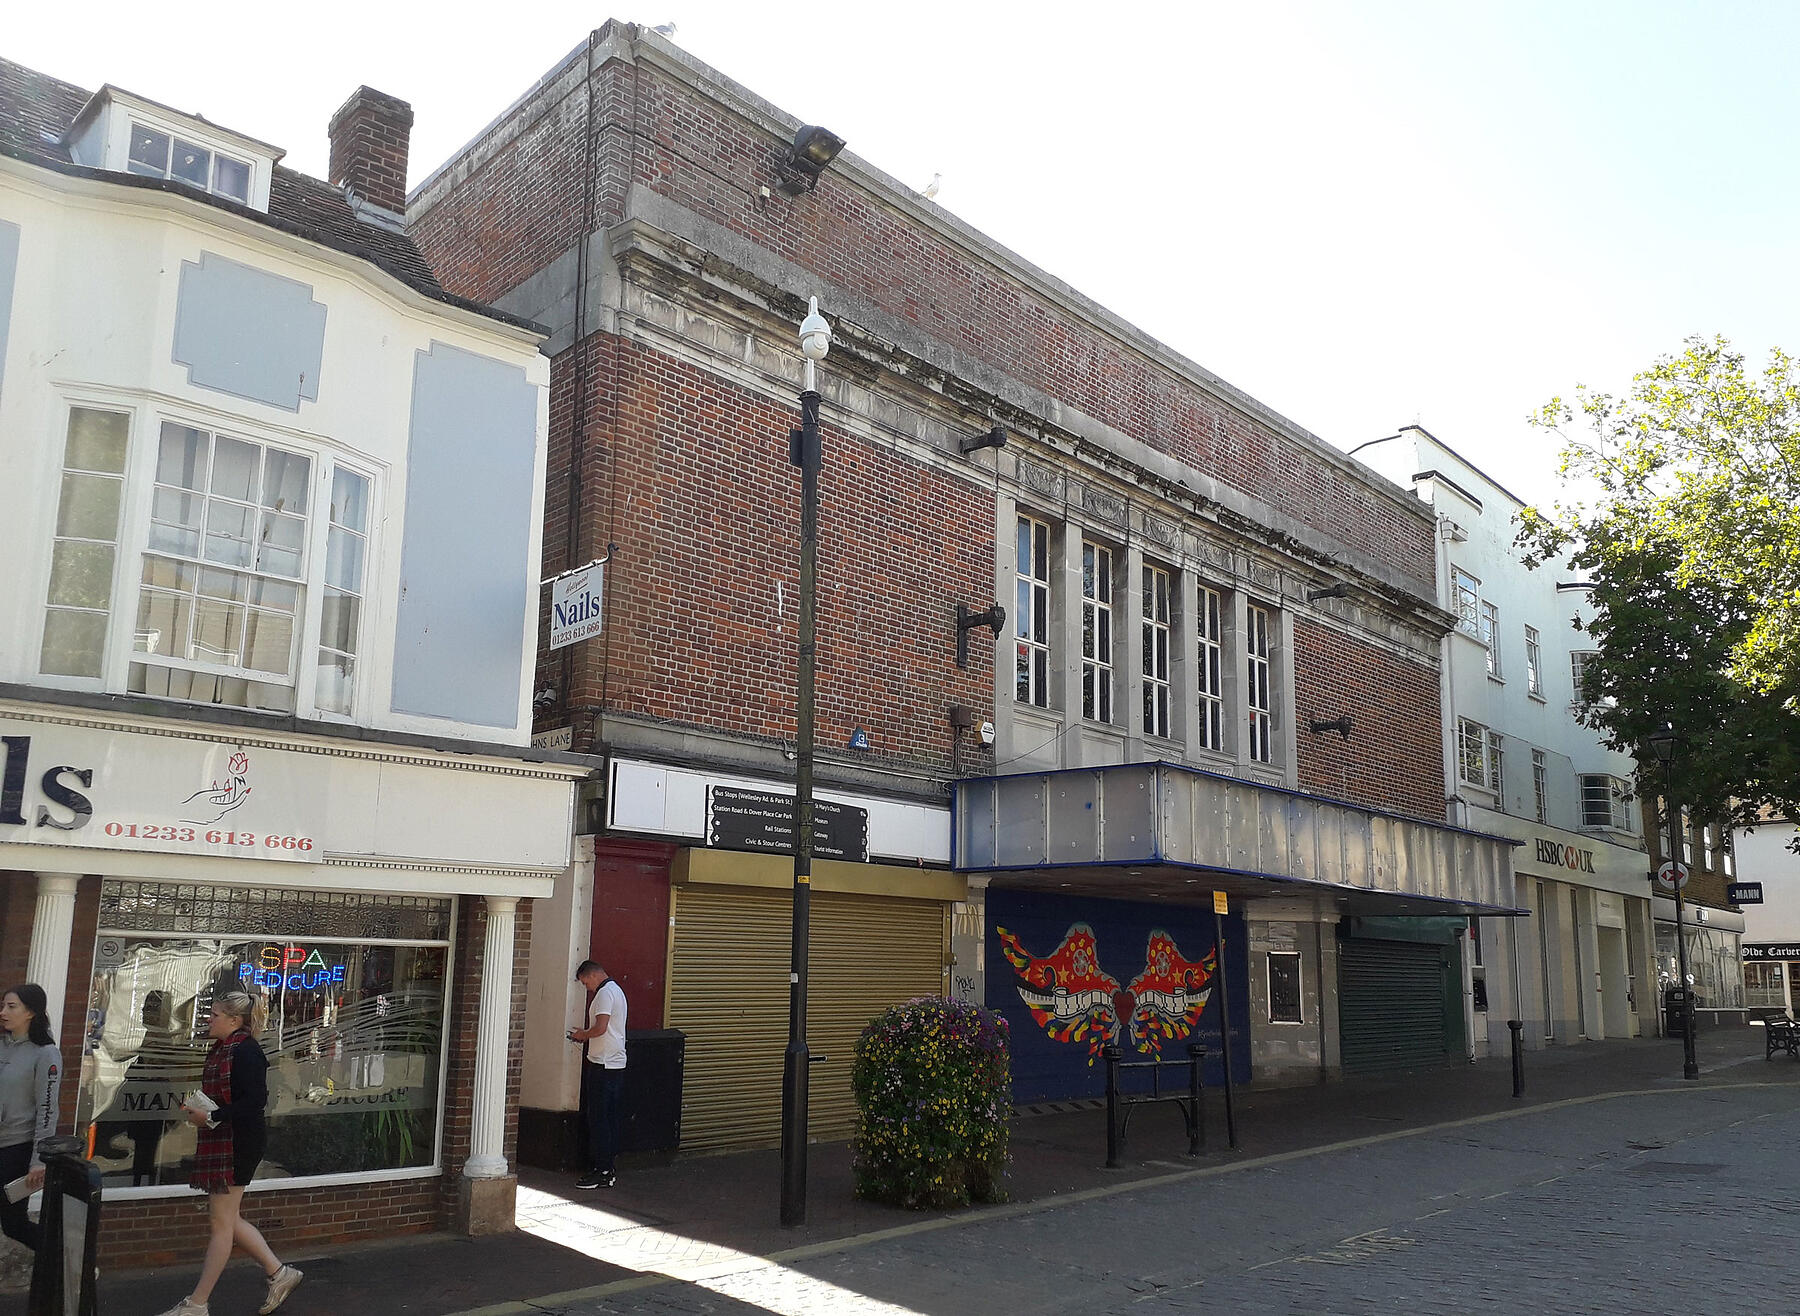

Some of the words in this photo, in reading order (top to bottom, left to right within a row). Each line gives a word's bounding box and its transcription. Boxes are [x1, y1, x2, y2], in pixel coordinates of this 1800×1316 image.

[553, 591, 600, 630] Nails
[552, 630, 572, 646] 01233
[573, 625, 586, 640] 613
[586, 620, 600, 634] 666
[551, 732, 570, 748] LANE
[714, 789, 724, 797] Bus
[724, 790, 738, 799] Stops
[713, 804, 731, 813] Station
[748, 809, 763, 817] Dover
[762, 810, 774, 818] Place
[783, 812, 793, 820] Park
[104, 821, 195, 843] 01233
[205, 829, 256, 847] 613
[264, 834, 313, 852] 666
[774, 826, 792, 834] Stations
[774, 841, 792, 849] Centres
[1535, 837, 1565, 867] HSBC
[1578, 848, 1596, 874] UK
[1735, 888, 1760, 900] MANN
[258, 946, 327, 970] SPA
[1741, 946, 1764, 957] Olde
